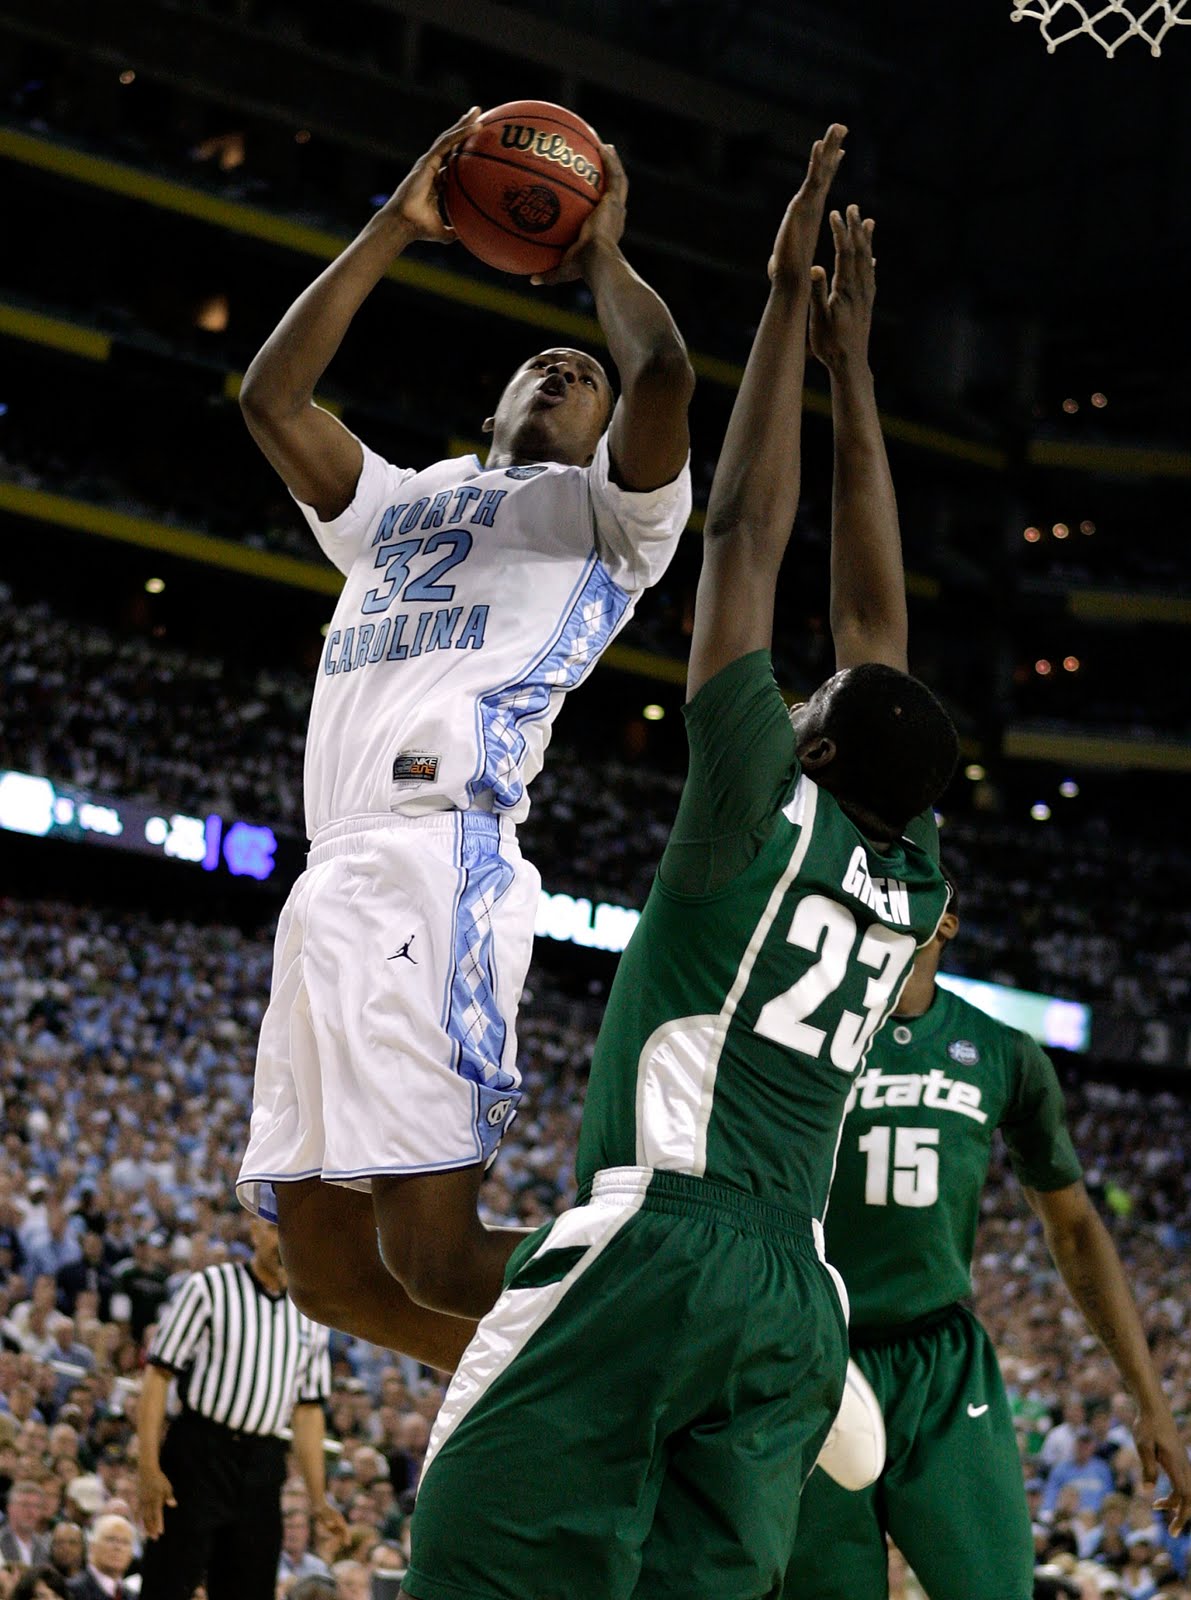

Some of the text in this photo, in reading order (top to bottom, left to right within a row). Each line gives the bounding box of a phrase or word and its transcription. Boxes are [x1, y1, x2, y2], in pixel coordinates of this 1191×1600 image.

[501, 124, 601, 187] Wilson
[371, 486, 508, 547] NORTH
[361, 529, 473, 615] 32
[324, 605, 490, 676] CAROLINA
[752, 894, 917, 1073] 23
[858, 1126, 940, 1207] 15
